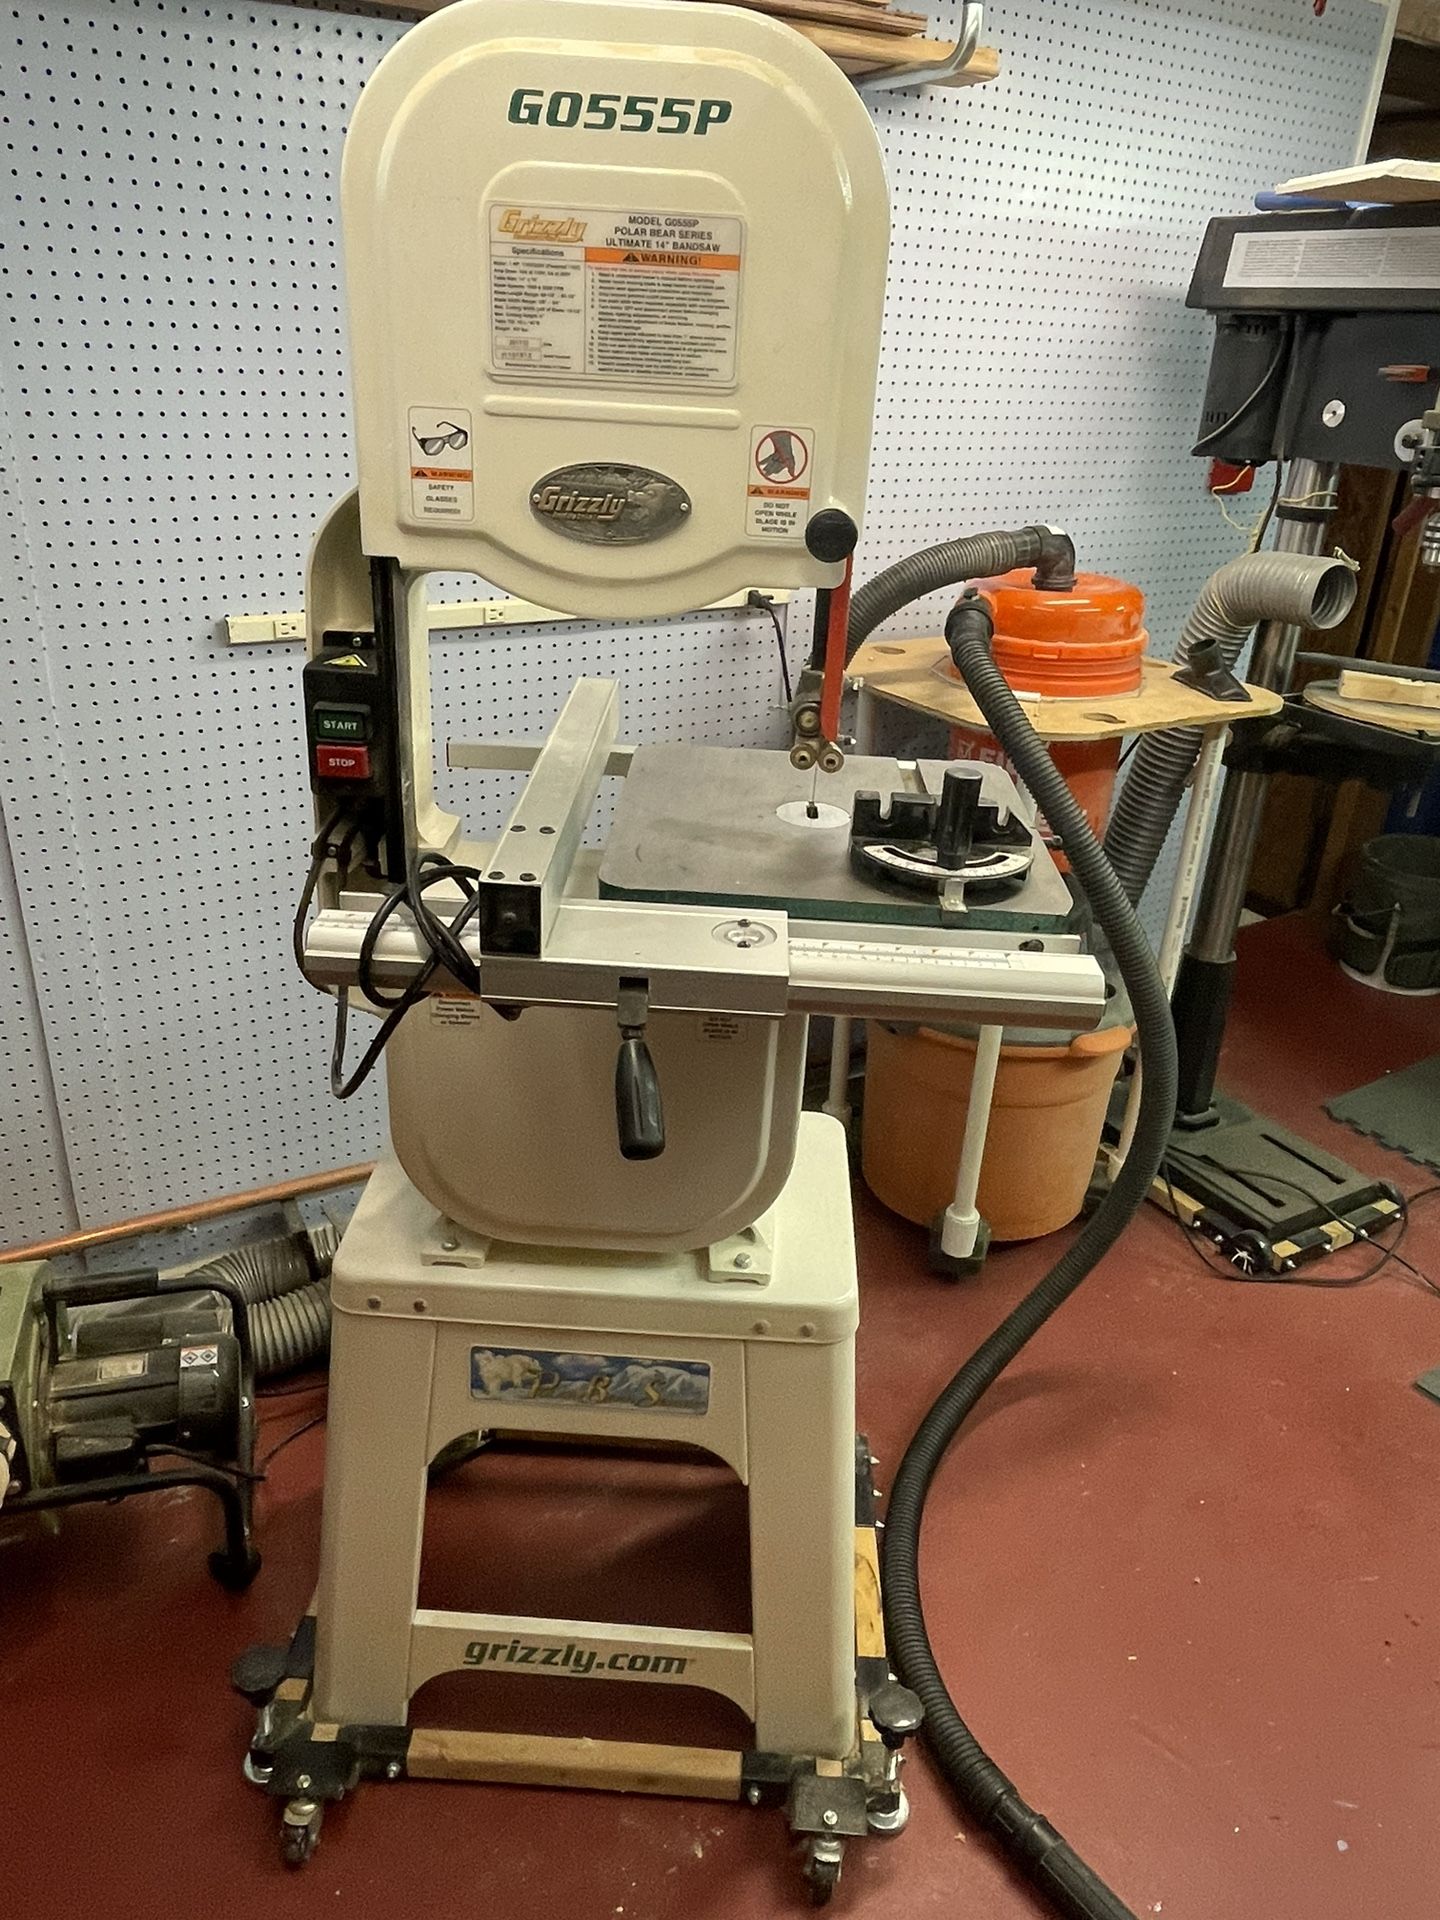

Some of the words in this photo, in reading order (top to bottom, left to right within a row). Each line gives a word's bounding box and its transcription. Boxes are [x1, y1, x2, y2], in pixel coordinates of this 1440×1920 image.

[508, 88, 732, 135] G0555P
[498, 209, 588, 243] Grizzly
[628, 216, 662, 226] MODEL
[614, 227, 647, 236] POLAR
[649, 228, 676, 239] BEAR
[678, 230, 713, 241] SERIES
[605, 237, 653, 249] ULTIMATE
[672, 241, 721, 253] BANDSAW
[640, 252, 702, 266] WARNING!
[537, 486, 626, 521] Grizzly
[323, 720, 357, 730] START
[328, 758, 356, 767] STOP
[463, 1639, 688, 1674] grizzly.com
